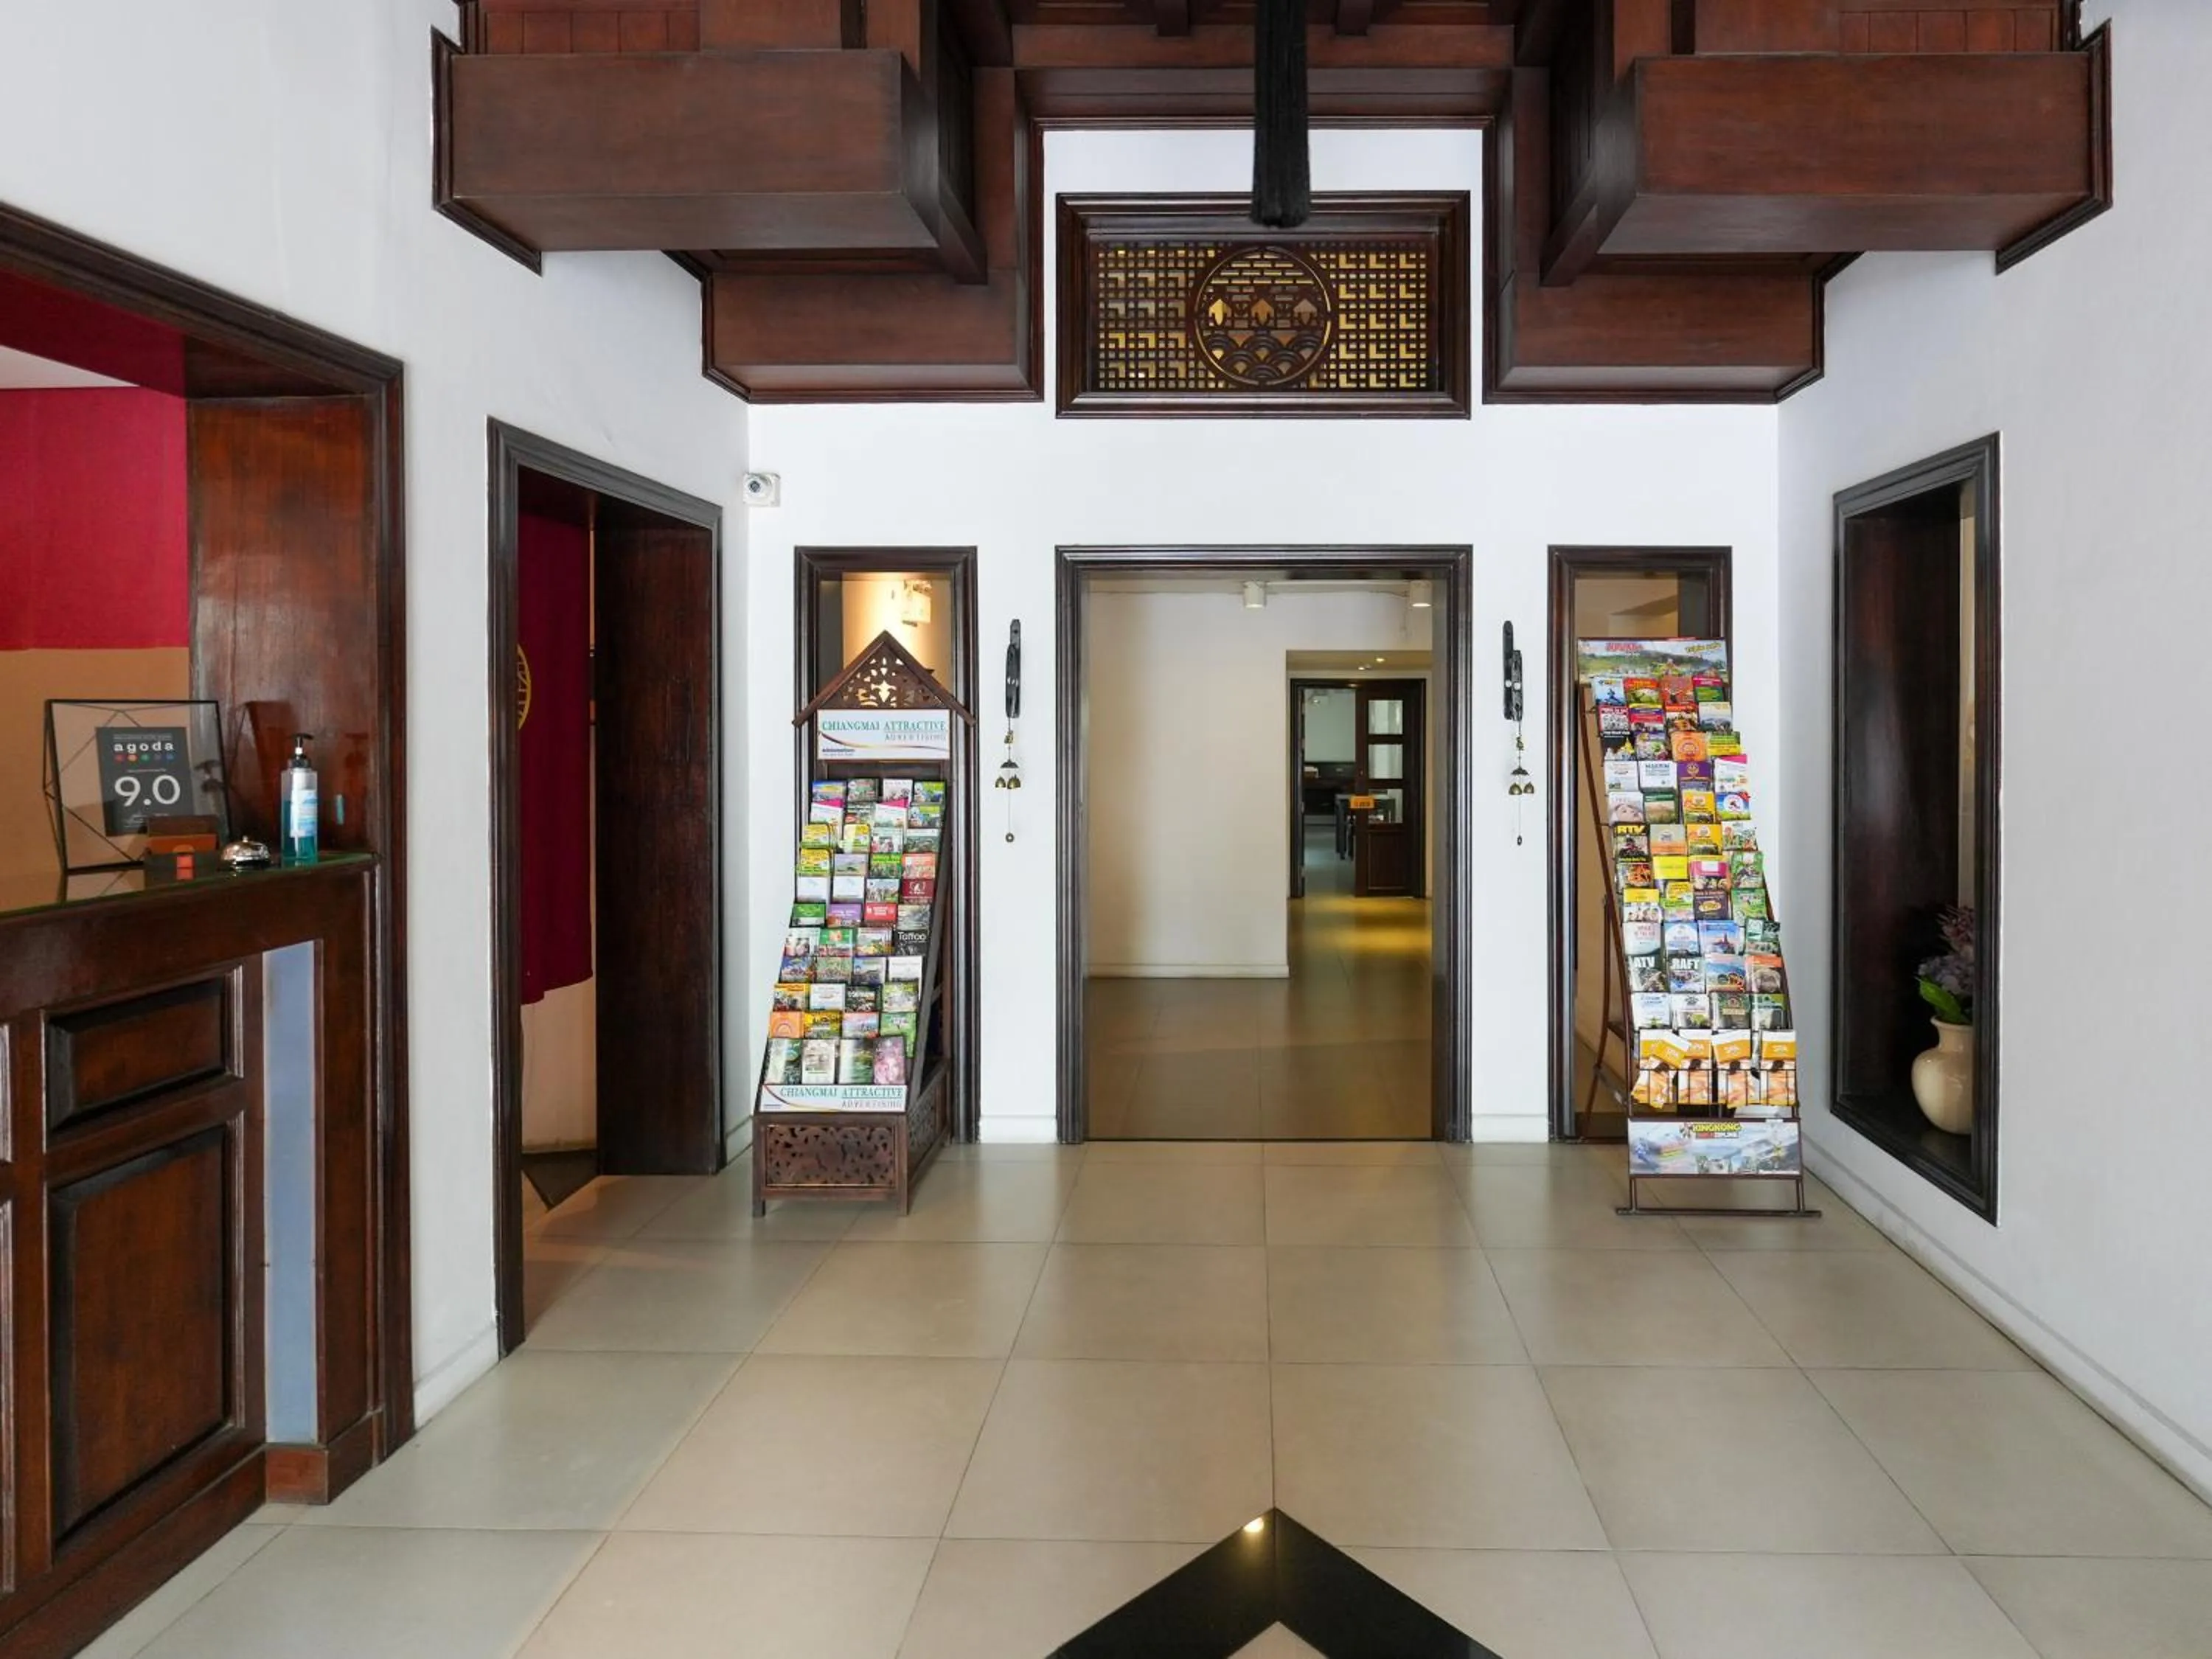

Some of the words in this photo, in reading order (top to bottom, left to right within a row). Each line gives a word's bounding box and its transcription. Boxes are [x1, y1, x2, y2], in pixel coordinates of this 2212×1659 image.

[821, 721, 880, 731] CHIANGMAI
[884, 720, 945, 731] ATTRACTIVE
[114, 740, 174, 754] agoda
[114, 774, 181, 807] 9.0
[780, 1087, 837, 1097] CHIANGMAI
[841, 1087, 903, 1097] ATTRACTIVE
